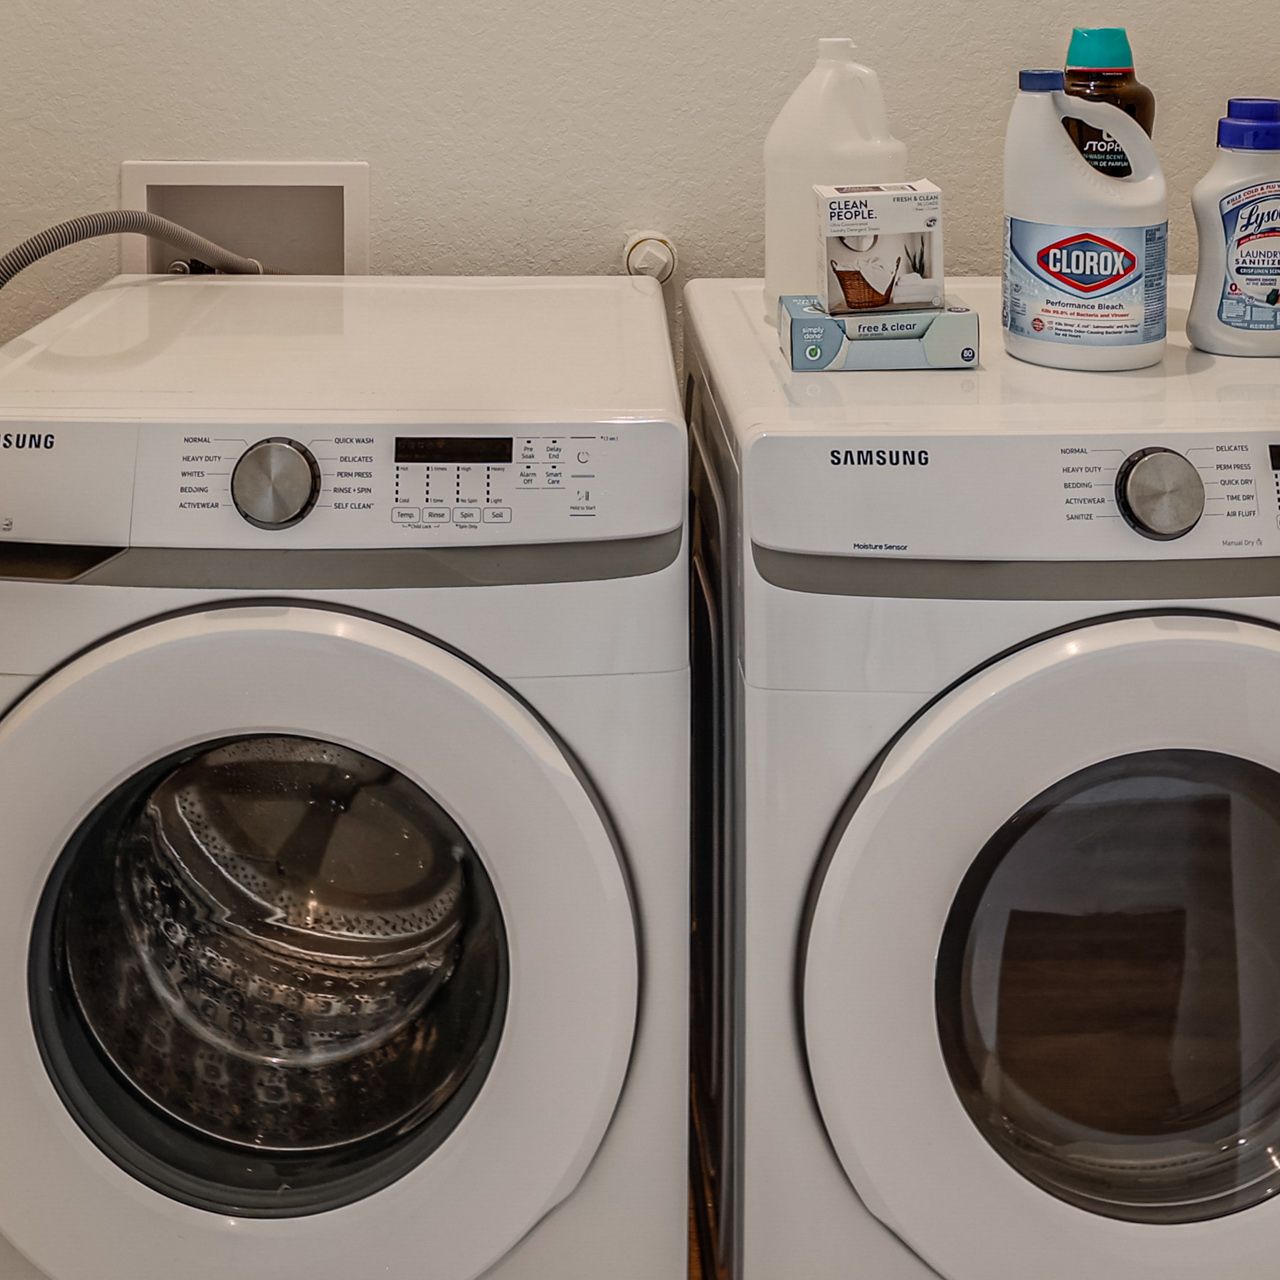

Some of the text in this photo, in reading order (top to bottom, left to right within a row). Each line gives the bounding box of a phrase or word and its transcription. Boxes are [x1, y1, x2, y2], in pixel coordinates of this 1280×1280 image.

[1243, 188, 1258, 197] COLD
[829, 200, 868, 210] CLEAN
[1048, 248, 1125, 276] CLOROX
[1046, 299, 1096, 310] Performance
[858, 324, 879, 332] free
[890, 322, 917, 331] clear
[830, 450, 929, 466] SAMSUNG
[1244, 539, 1254, 548] Dry
